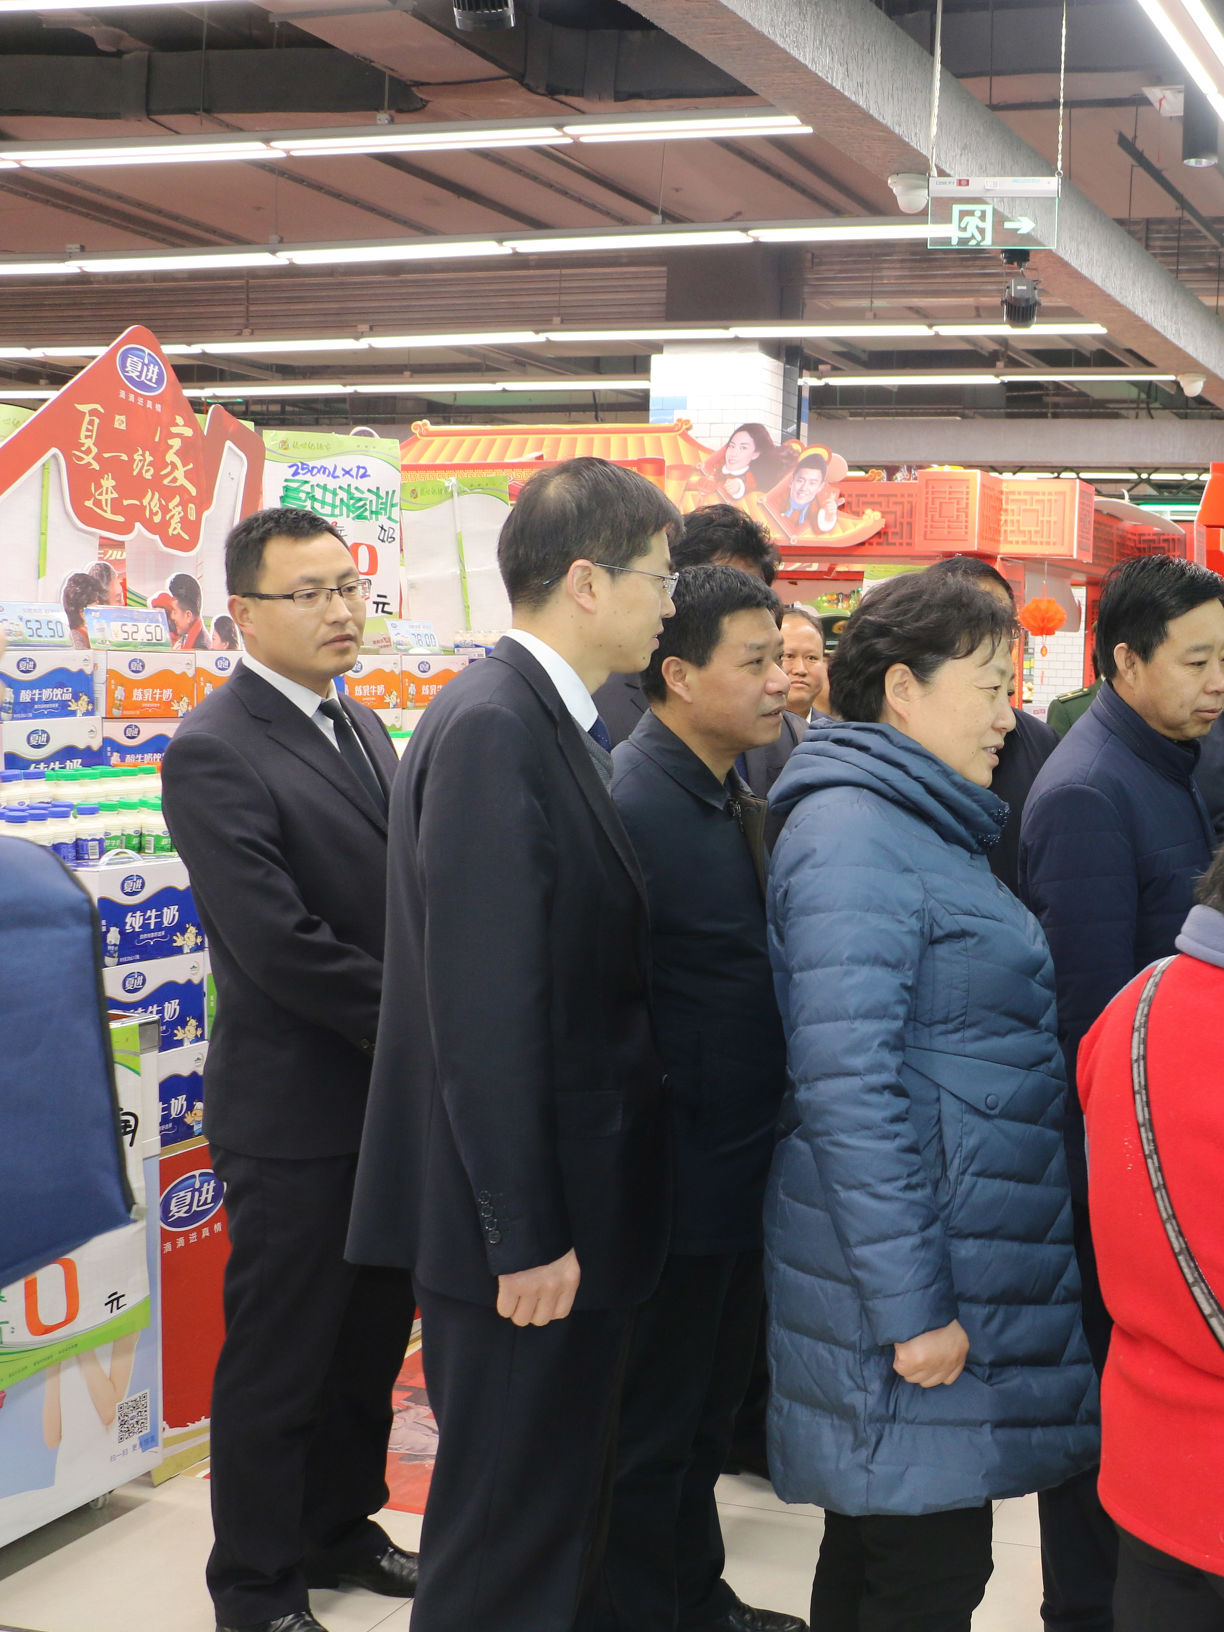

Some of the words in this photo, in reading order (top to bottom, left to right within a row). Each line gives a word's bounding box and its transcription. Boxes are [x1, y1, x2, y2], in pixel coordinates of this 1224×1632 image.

[124, 354, 160, 388] 夏进
[83, 472, 190, 541] 进一份爱
[372, 593, 394, 616] 元
[25, 619, 65, 639] 52.50
[120, 623, 163, 642] 52.50
[19, 687, 73, 703] 酸牛奶饮品
[132, 687, 174, 702] 炼乳牛奶
[29, 733, 49, 746] 夏进
[125, 752, 166, 763] 酸牛奶饮
[123, 878, 143, 893] 夏进
[125, 905, 179, 933] 纯牛奶
[125, 975, 144, 992] 夏进
[168, 1180, 216, 1222] 夏进
[162, 1222, 223, 1255] 滴滴进真情
[104, 1290, 127, 1314] 元
